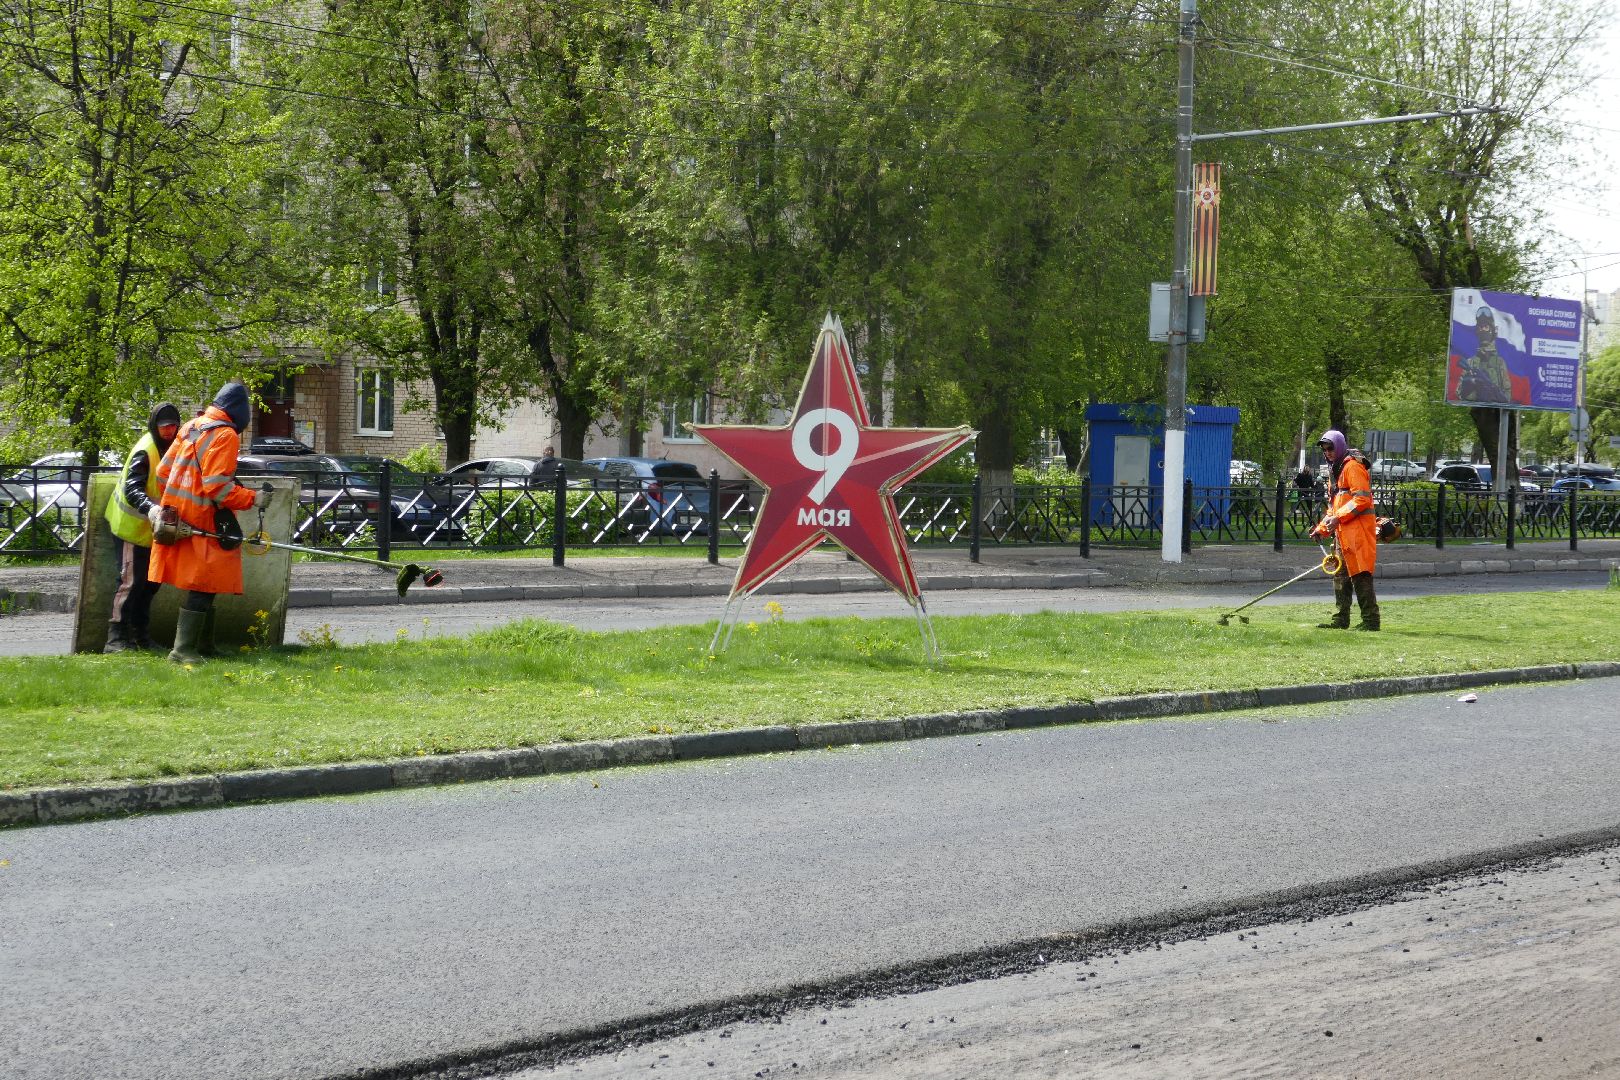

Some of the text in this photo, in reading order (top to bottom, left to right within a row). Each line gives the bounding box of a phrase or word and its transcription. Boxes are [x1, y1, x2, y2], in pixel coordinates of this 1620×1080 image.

[1528, 307, 1576, 319] ВОЕННАЯ СЛУЖБА
[1538, 318, 1576, 328] ПО КОНТРАКТУ
[792, 408, 859, 505] 9
[797, 508, 851, 527] мая
